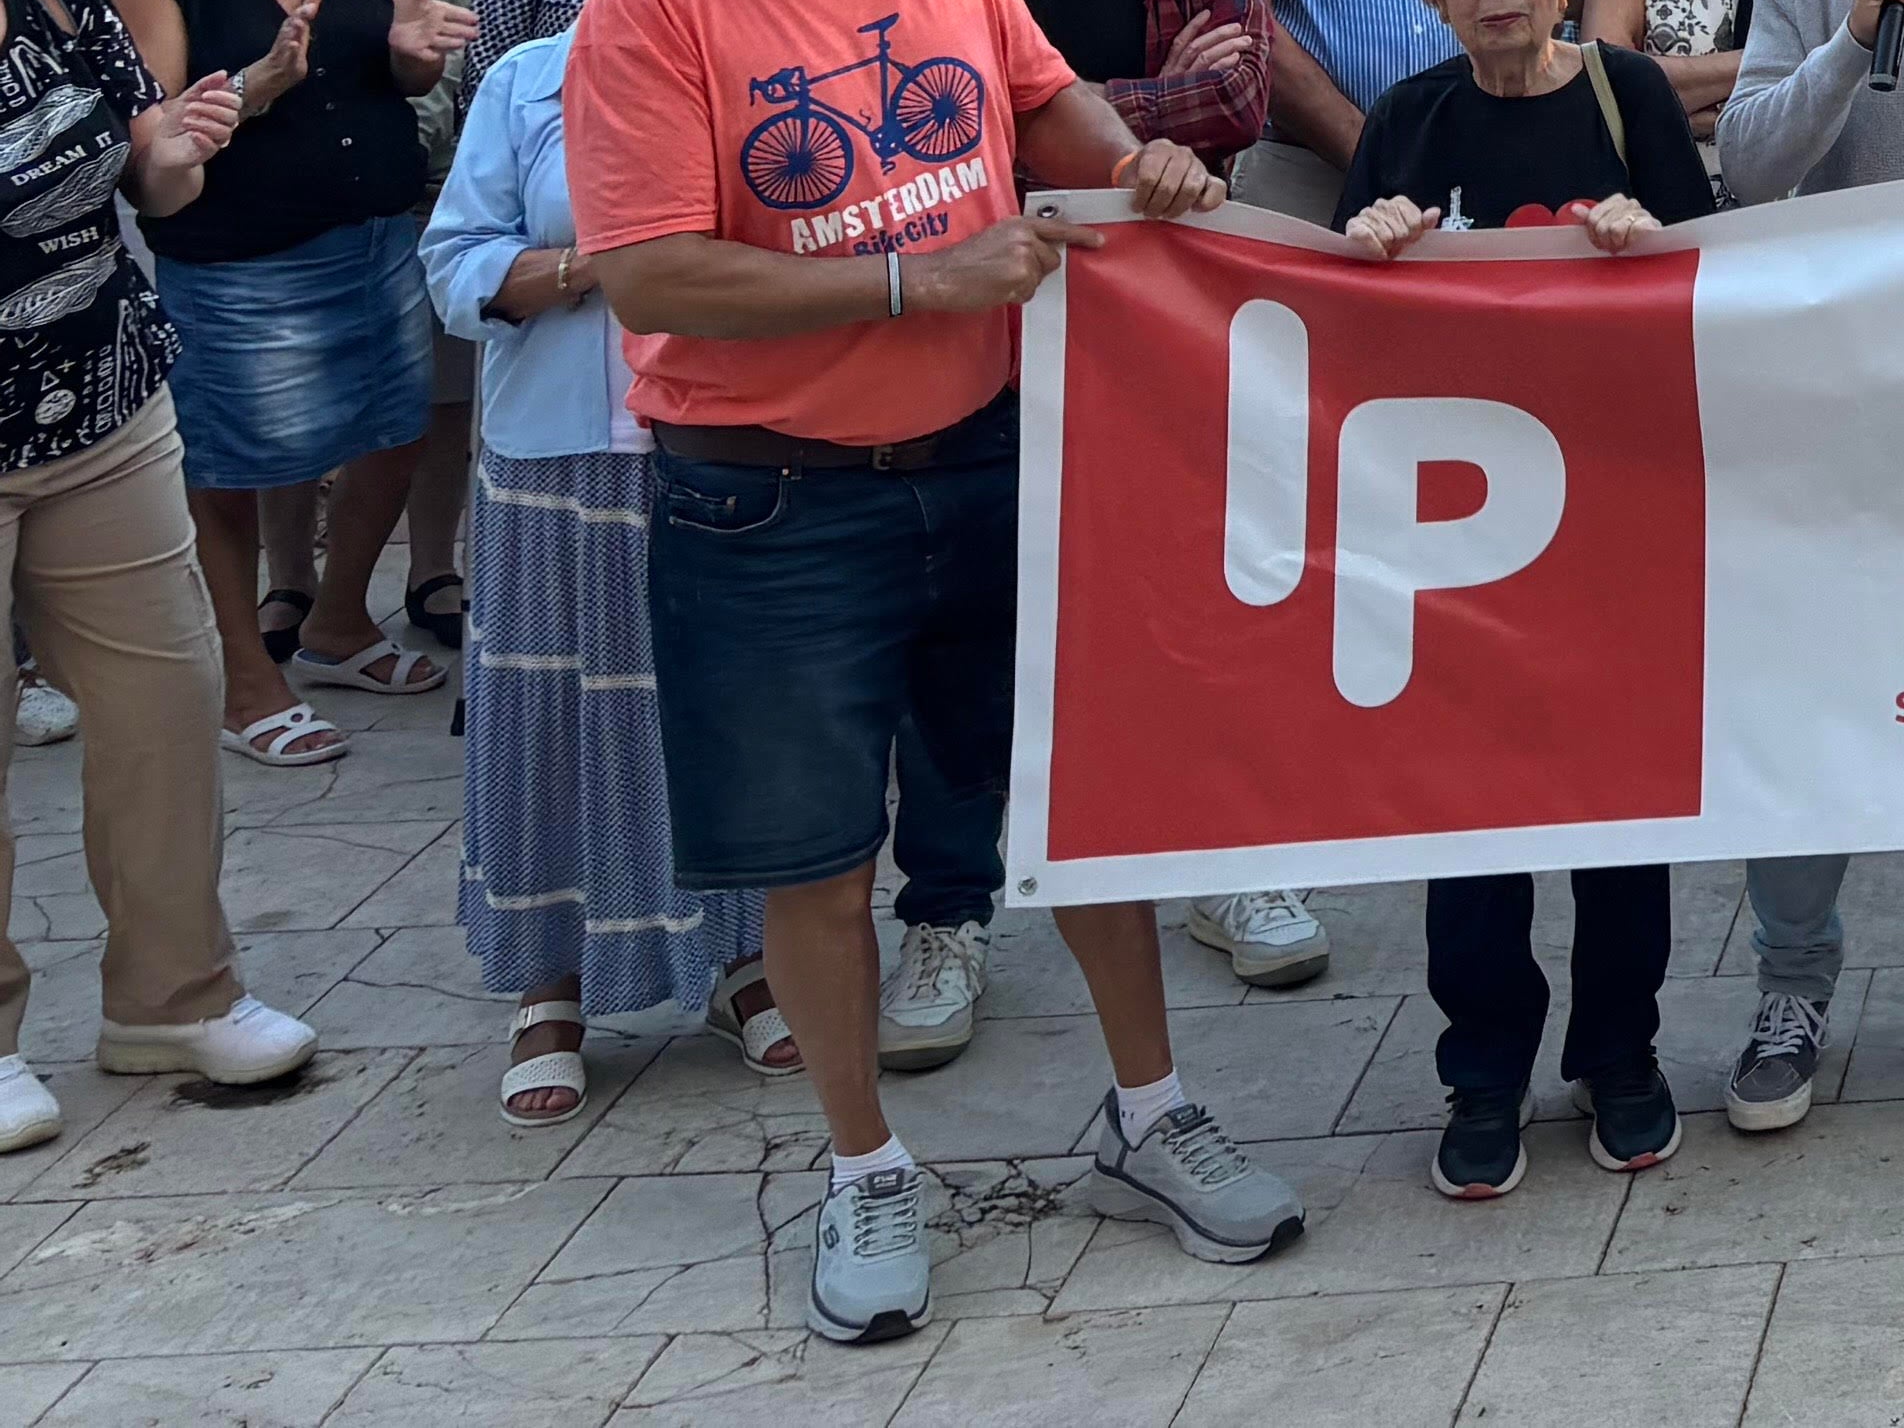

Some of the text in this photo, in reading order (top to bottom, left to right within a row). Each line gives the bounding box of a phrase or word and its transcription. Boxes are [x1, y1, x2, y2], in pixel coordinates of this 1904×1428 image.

[10, 145, 87, 186] DREAM
[790, 156, 989, 255] AMSTERDAM
[38, 226, 99, 254] WISH
